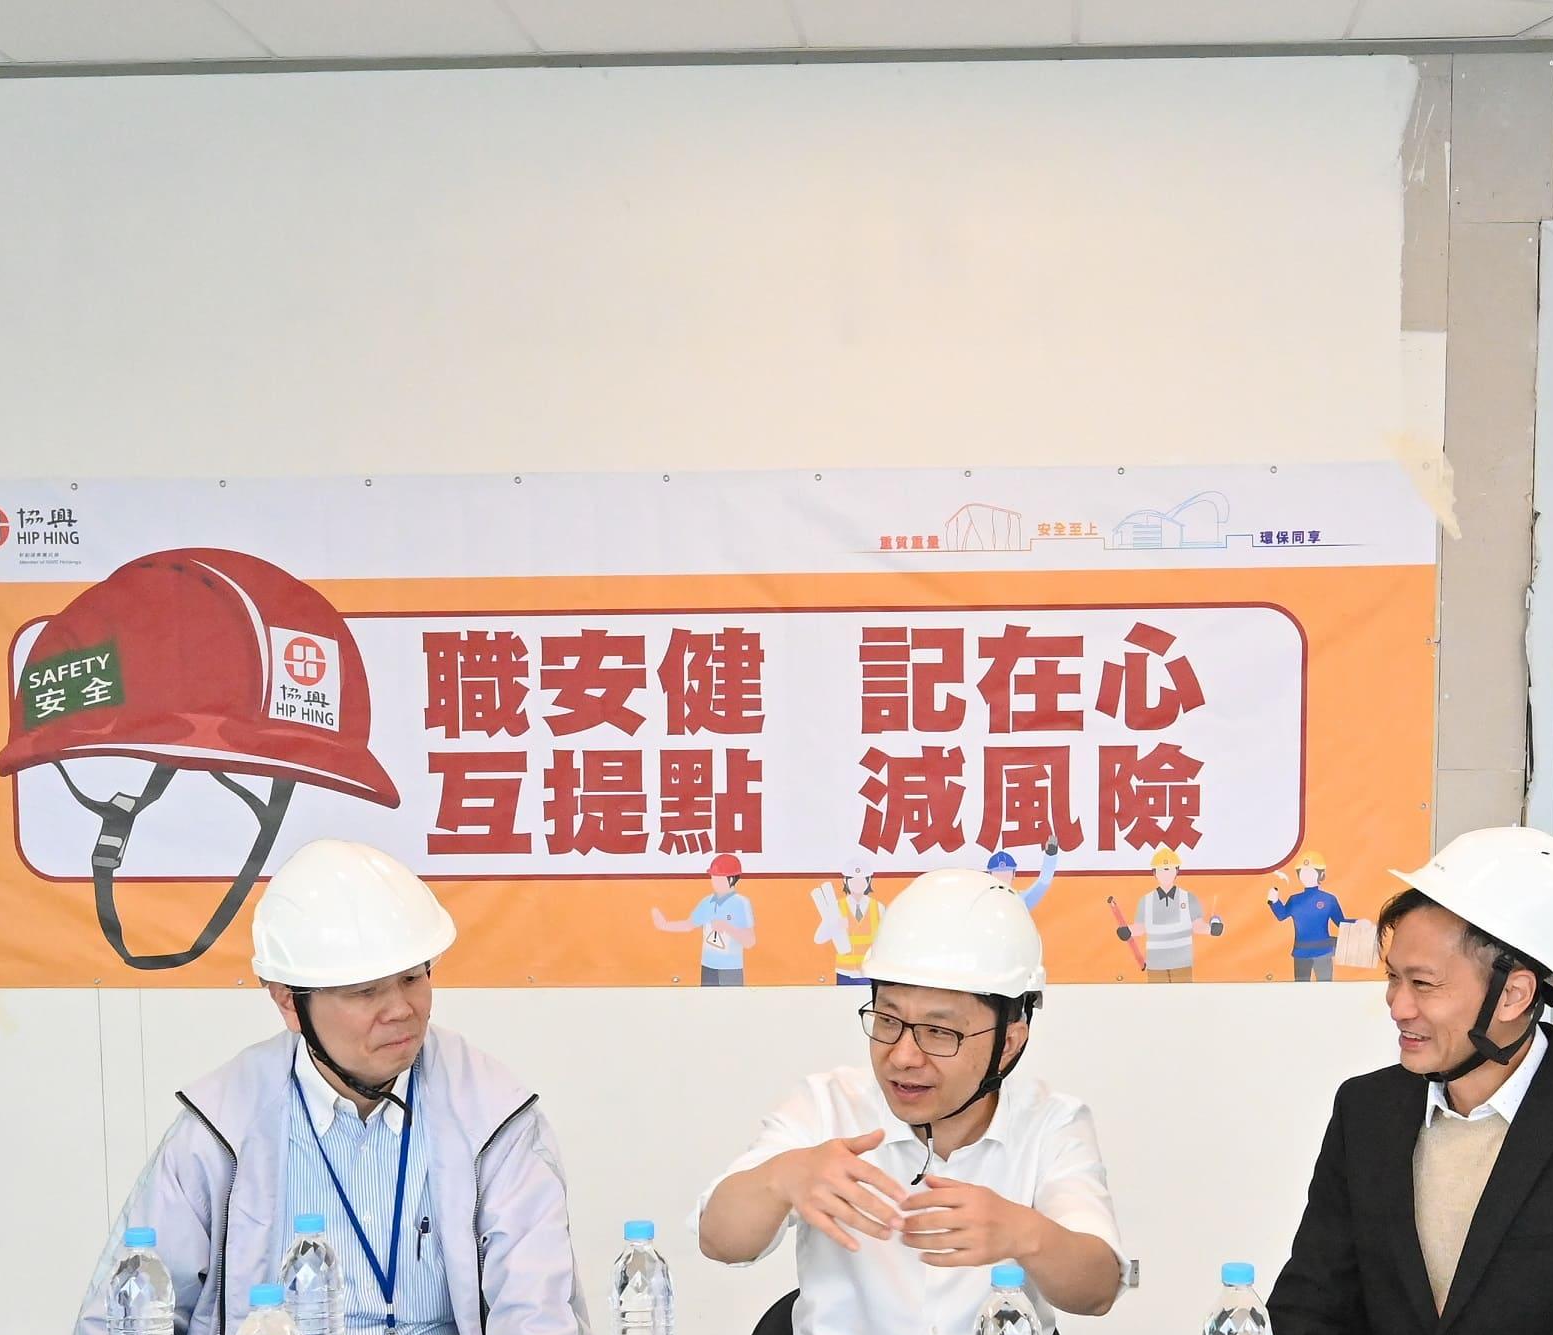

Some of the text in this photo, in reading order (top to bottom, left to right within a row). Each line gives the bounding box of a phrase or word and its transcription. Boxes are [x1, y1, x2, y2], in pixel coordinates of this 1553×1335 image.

[17, 532, 80, 545] HIP HING
[1037, 521, 1099, 536] 安全至上
[1259, 530, 1322, 545] 環保同享
[28, 652, 111, 689] SAFETY
[422, 621, 1206, 739] 職安健 記在心
[35, 676, 114, 719] 安全
[276, 701, 335, 727] HIP HING
[426, 742, 1206, 857] 互提點 減風險
